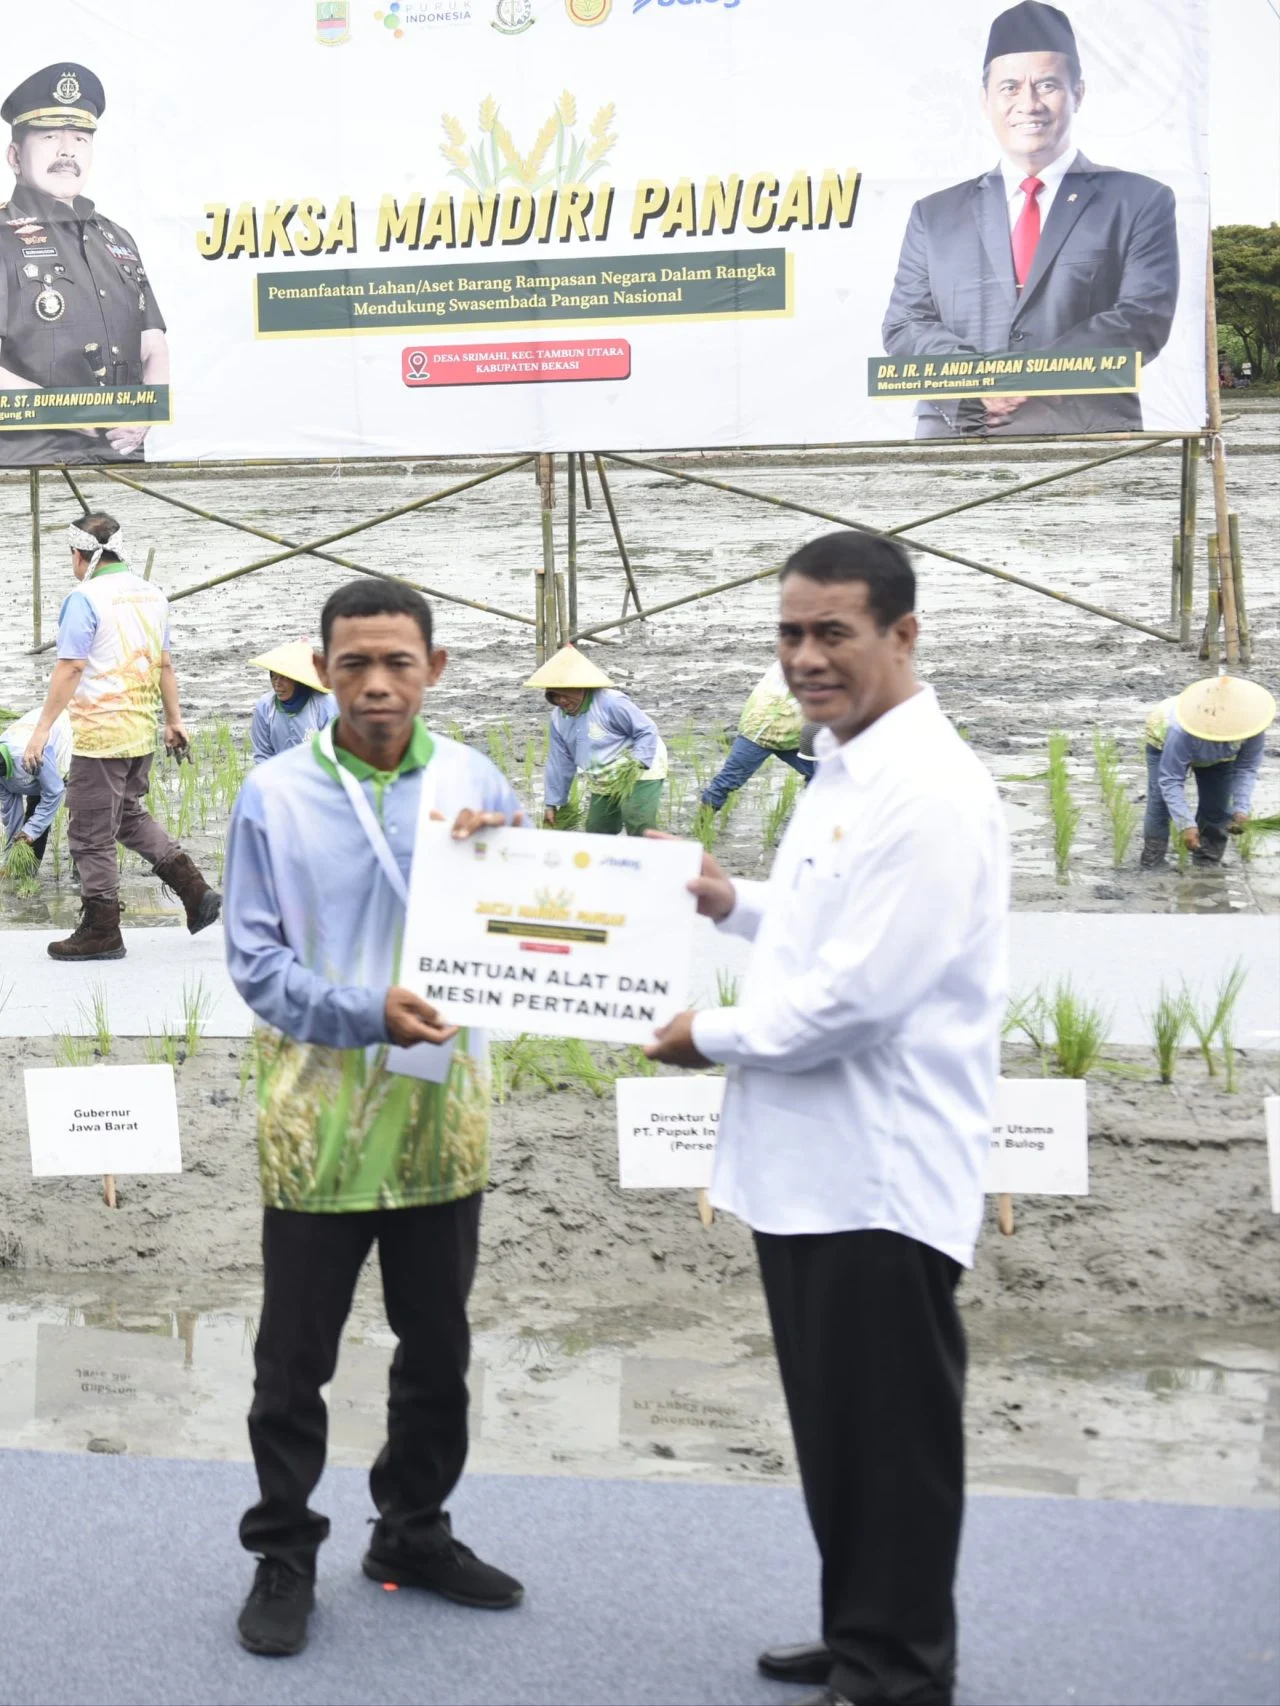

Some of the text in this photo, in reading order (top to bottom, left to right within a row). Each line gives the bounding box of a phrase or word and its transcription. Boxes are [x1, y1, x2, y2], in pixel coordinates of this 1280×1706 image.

[406, 11, 471, 24] INDONESIA
[196, 167, 862, 260] JAKSA MANDIRI PANGAN
[268, 263, 776, 300] Pemanfaatan Lahan/Aset Barang Rampasan Negara Dalam Rangka
[353, 288, 683, 316] Mendukung Swasembada Pangan Nasional
[433, 353, 460, 363] DESA
[511, 351, 535, 360] KEC.
[537, 349, 585, 359] TAMBUN
[587, 347, 624, 357] UTARA
[476, 361, 580, 373] KABUPATEN BEKASI
[877, 355, 1127, 379] DR. IR. H. ANDI AMRAN SULAIMAN, M.P
[878, 377, 995, 390] Menteri Pertanian RI
[14, 394, 30, 407] ST.
[34, 391, 113, 407] BURHANUDDIN
[25, 410, 35, 418] RI
[419, 957, 669, 996] BANTUAN ALAT DAN
[426, 984, 655, 1021] MESIN PERTANIAN
[73, 1108, 131, 1118] Gubernur
[650, 1112, 705, 1122] Direktur
[68, 1121, 138, 1132] Jawa Barat
[633, 1127, 652, 1137] PT.
[657, 1127, 699, 1138] Pupuk
[1007, 1124, 1054, 1134] Utama
[670, 1140, 716, 1152] (Perse
[1004, 1138, 1045, 1151] Bulog
